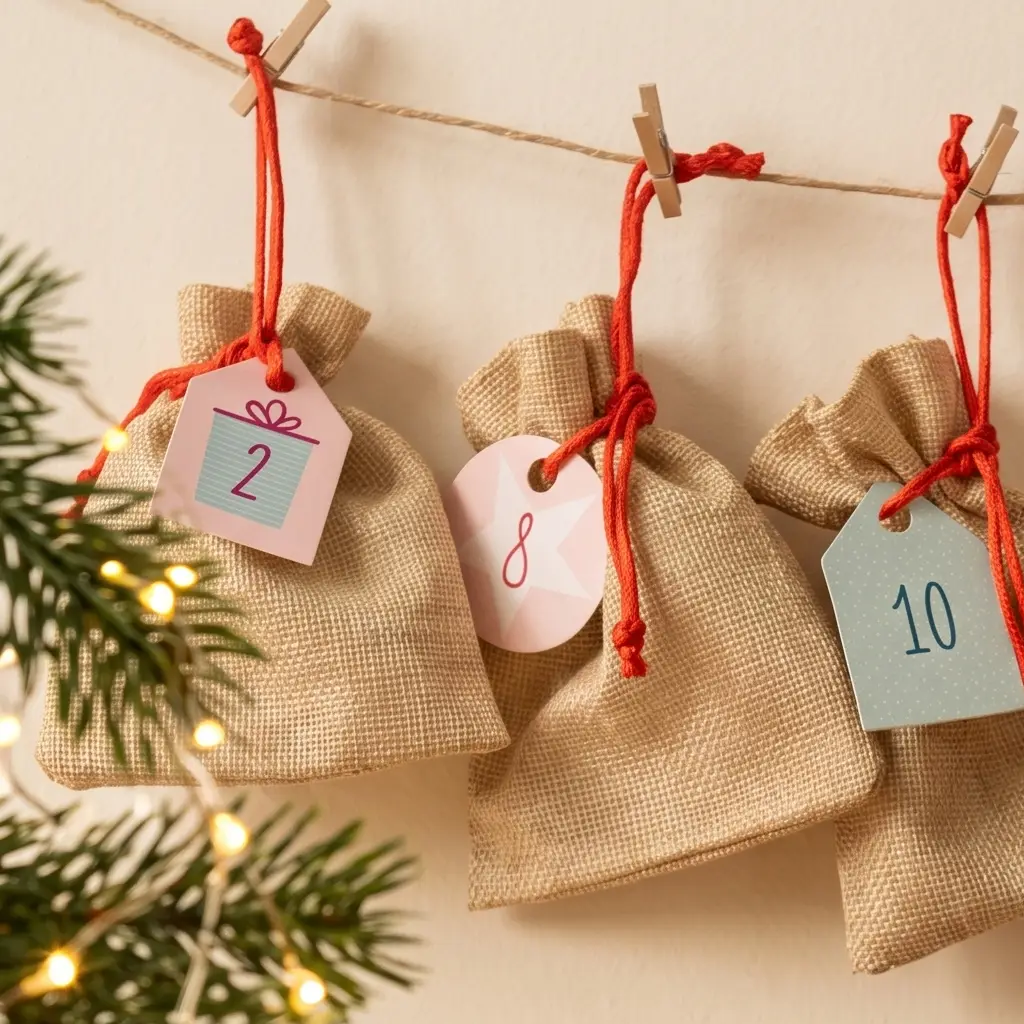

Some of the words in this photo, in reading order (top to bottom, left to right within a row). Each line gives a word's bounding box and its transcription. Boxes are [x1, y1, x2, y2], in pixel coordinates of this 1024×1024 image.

[231, 444, 271, 501] 2
[503, 512, 533, 588] 8
[892, 581, 956, 655] 10
